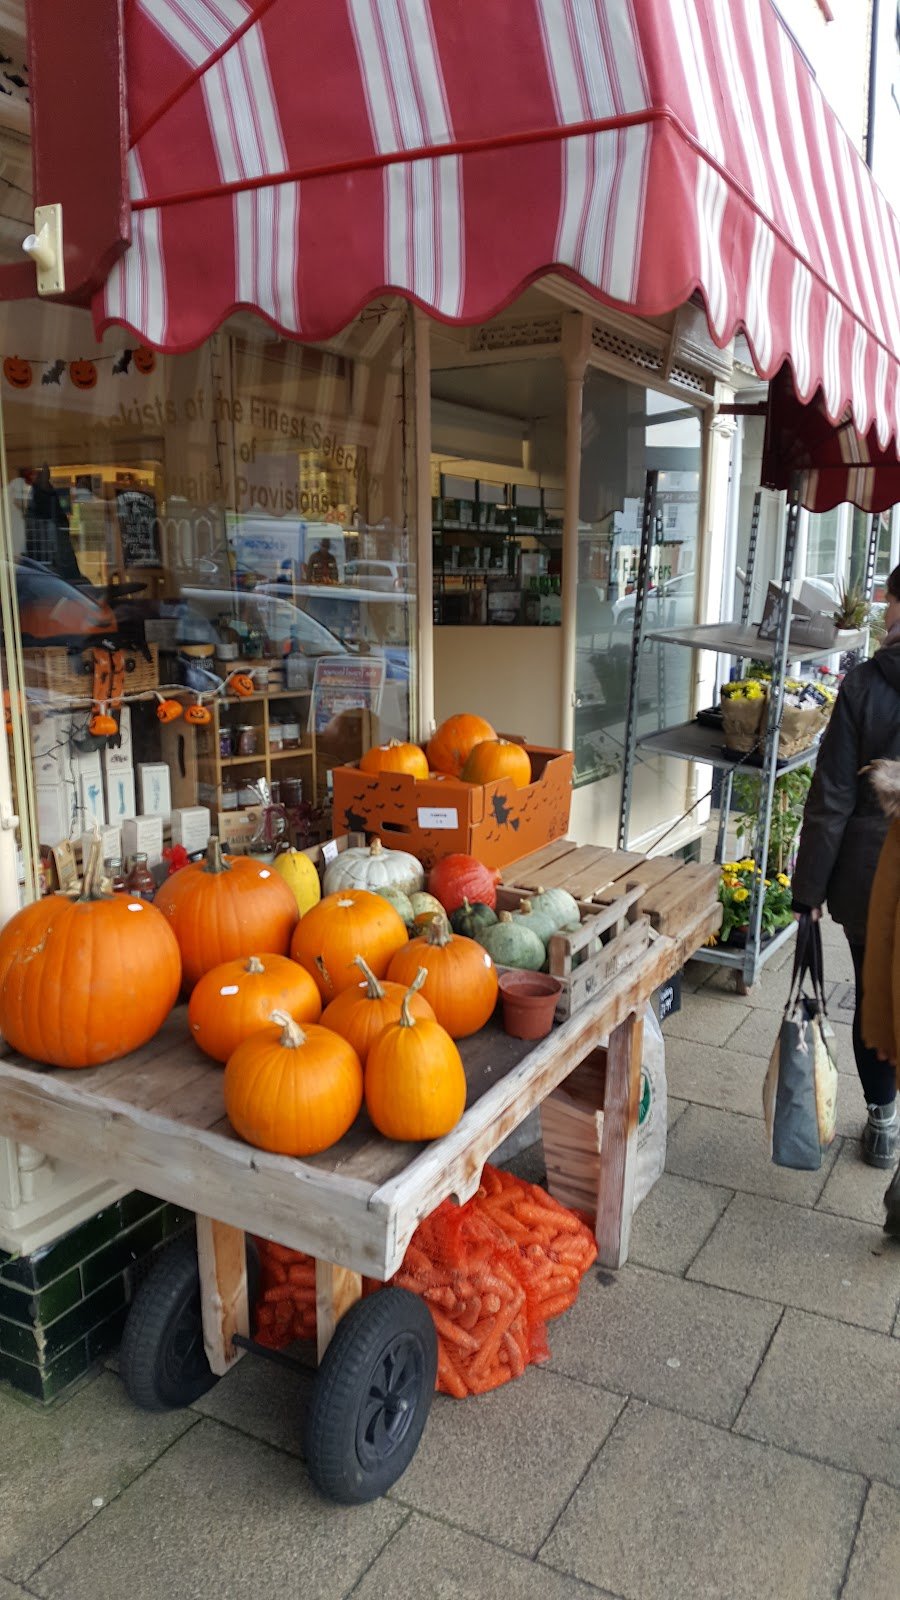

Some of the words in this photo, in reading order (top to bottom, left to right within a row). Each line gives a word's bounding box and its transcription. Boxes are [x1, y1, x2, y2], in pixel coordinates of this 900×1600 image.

[185, 389, 207, 423] of
[251, 398, 307, 442] Finest
[240, 437, 257, 465] of
[236, 475, 330, 513] Provisions
